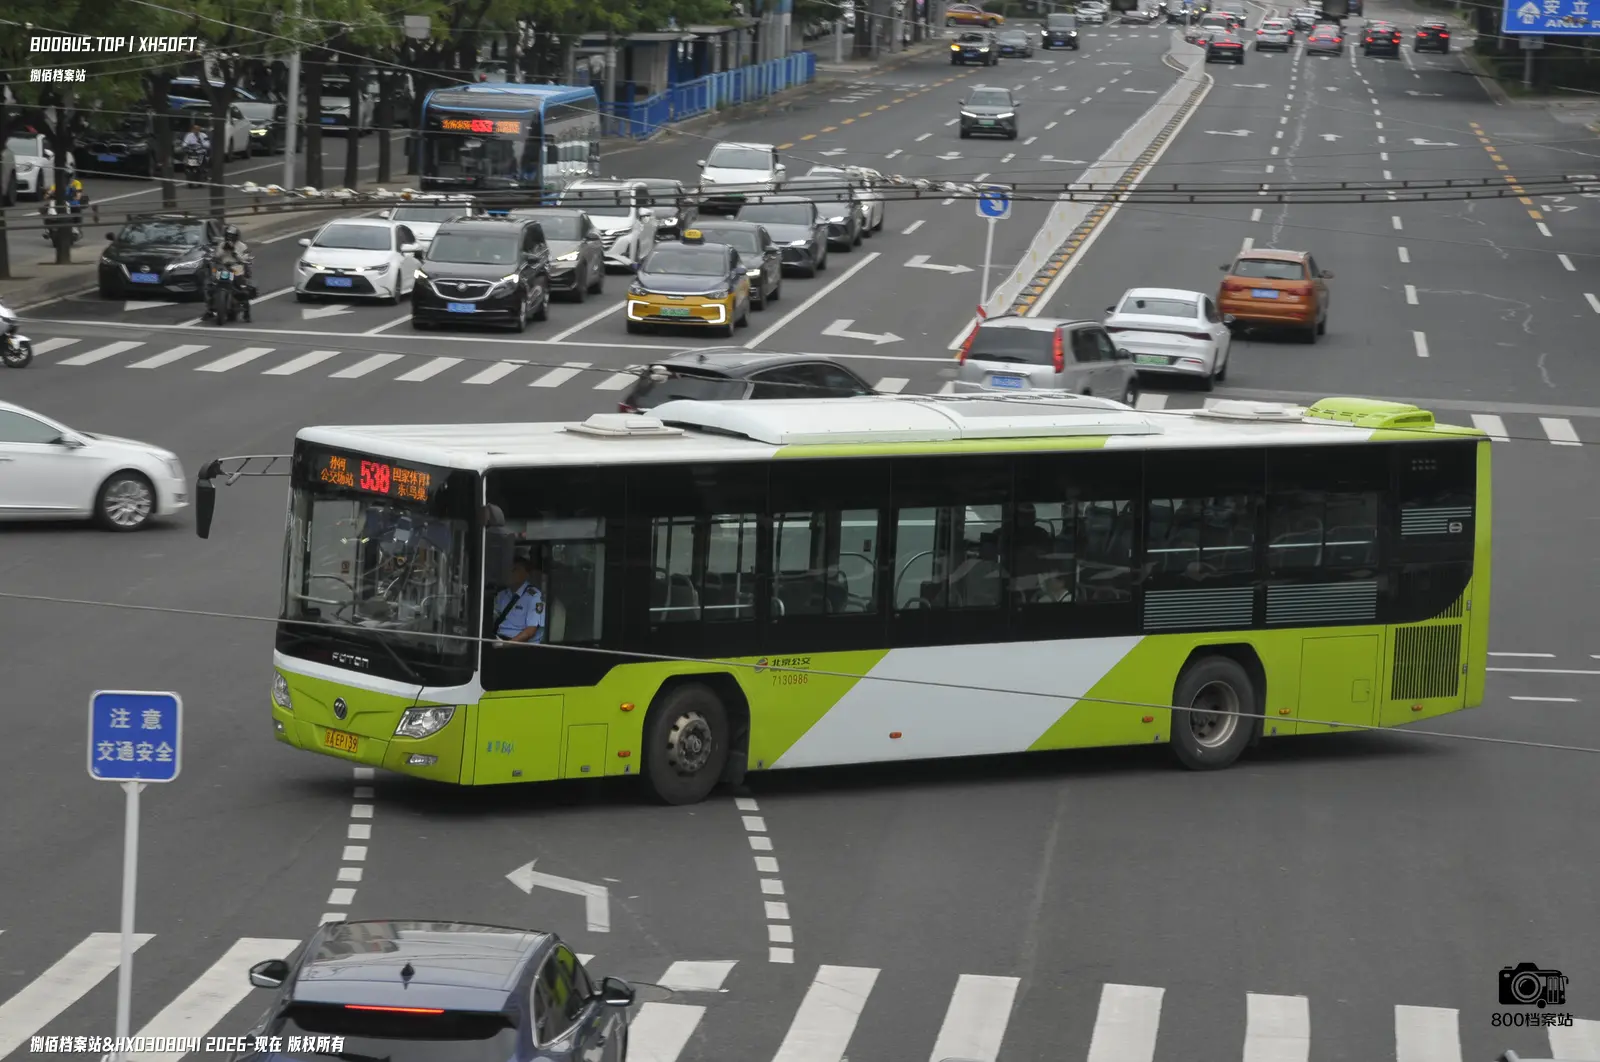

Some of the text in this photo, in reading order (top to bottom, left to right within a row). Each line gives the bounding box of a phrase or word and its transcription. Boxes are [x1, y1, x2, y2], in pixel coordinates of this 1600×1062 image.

[321, 468, 354, 487] 公交场站
[360, 460, 391, 493] 538
[332, 652, 369, 669] FOTON
[771, 657, 811, 667] 北京公交
[772, 674, 808, 687] 7130986
[109, 708, 162, 729] 注意
[97, 740, 174, 762] 交通安全
